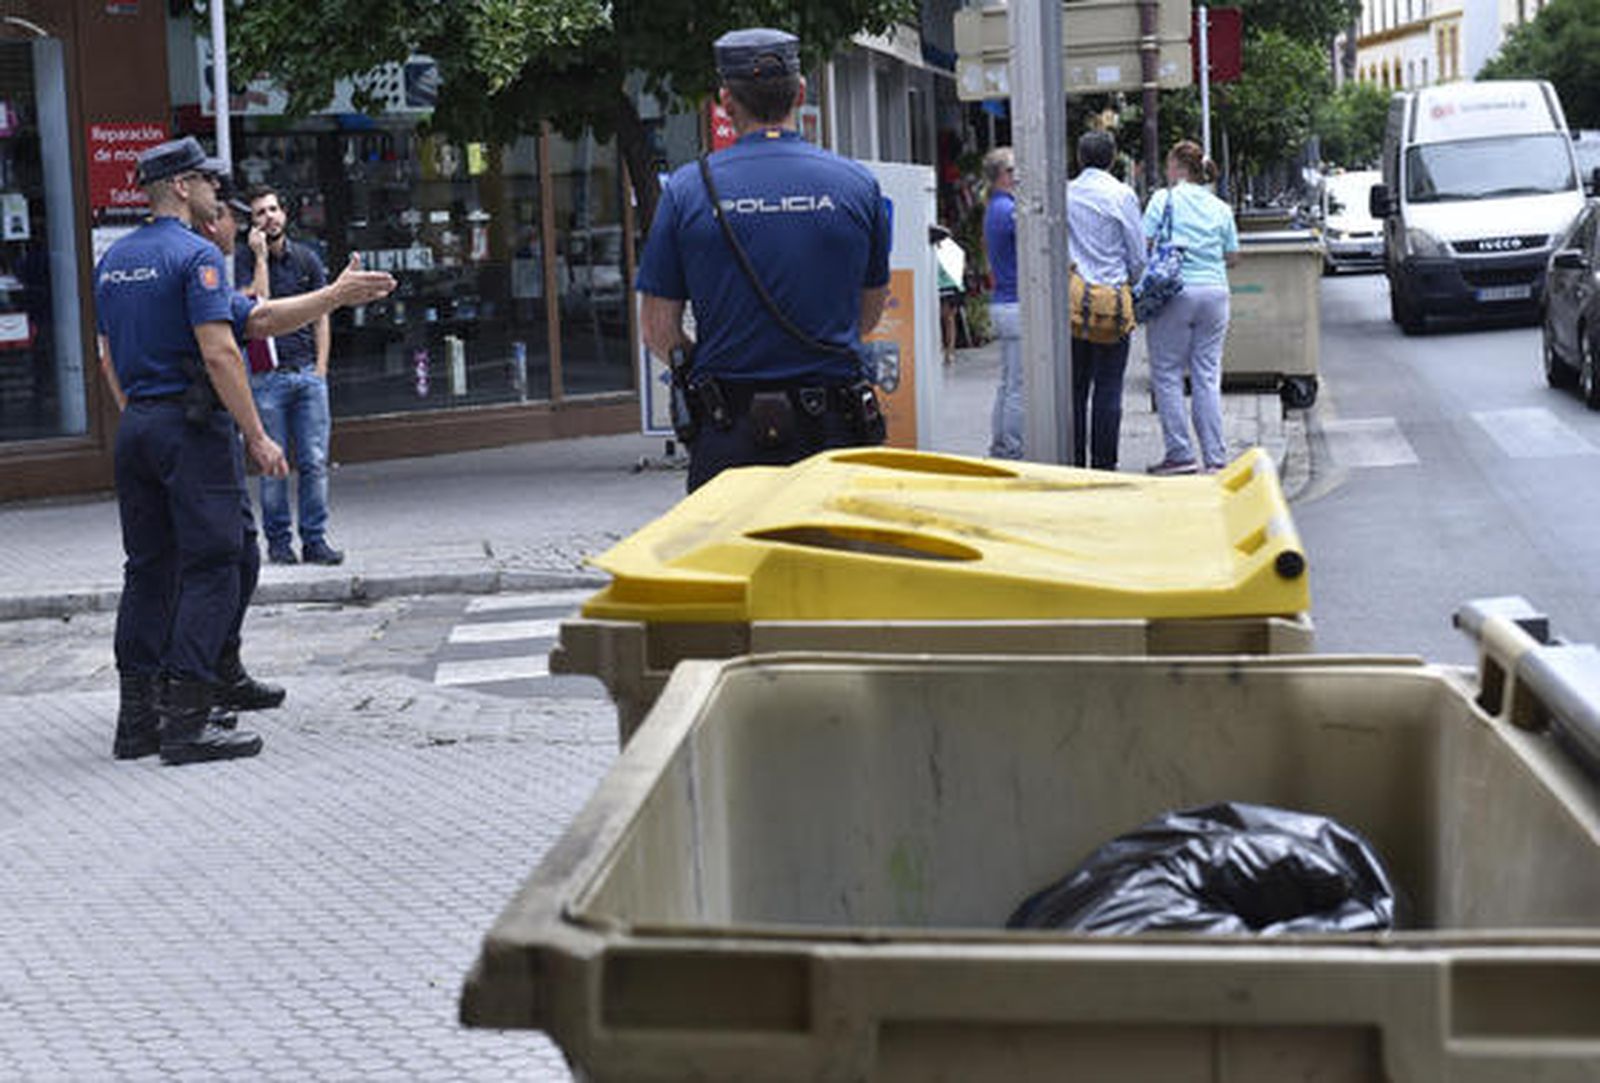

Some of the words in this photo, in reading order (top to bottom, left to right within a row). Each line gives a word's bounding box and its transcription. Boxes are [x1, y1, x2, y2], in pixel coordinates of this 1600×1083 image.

[91, 125, 164, 143] Reparación
[94, 147, 112, 161] de
[713, 195, 836, 217] POLICIA
[1479, 239, 1522, 250] IVECO
